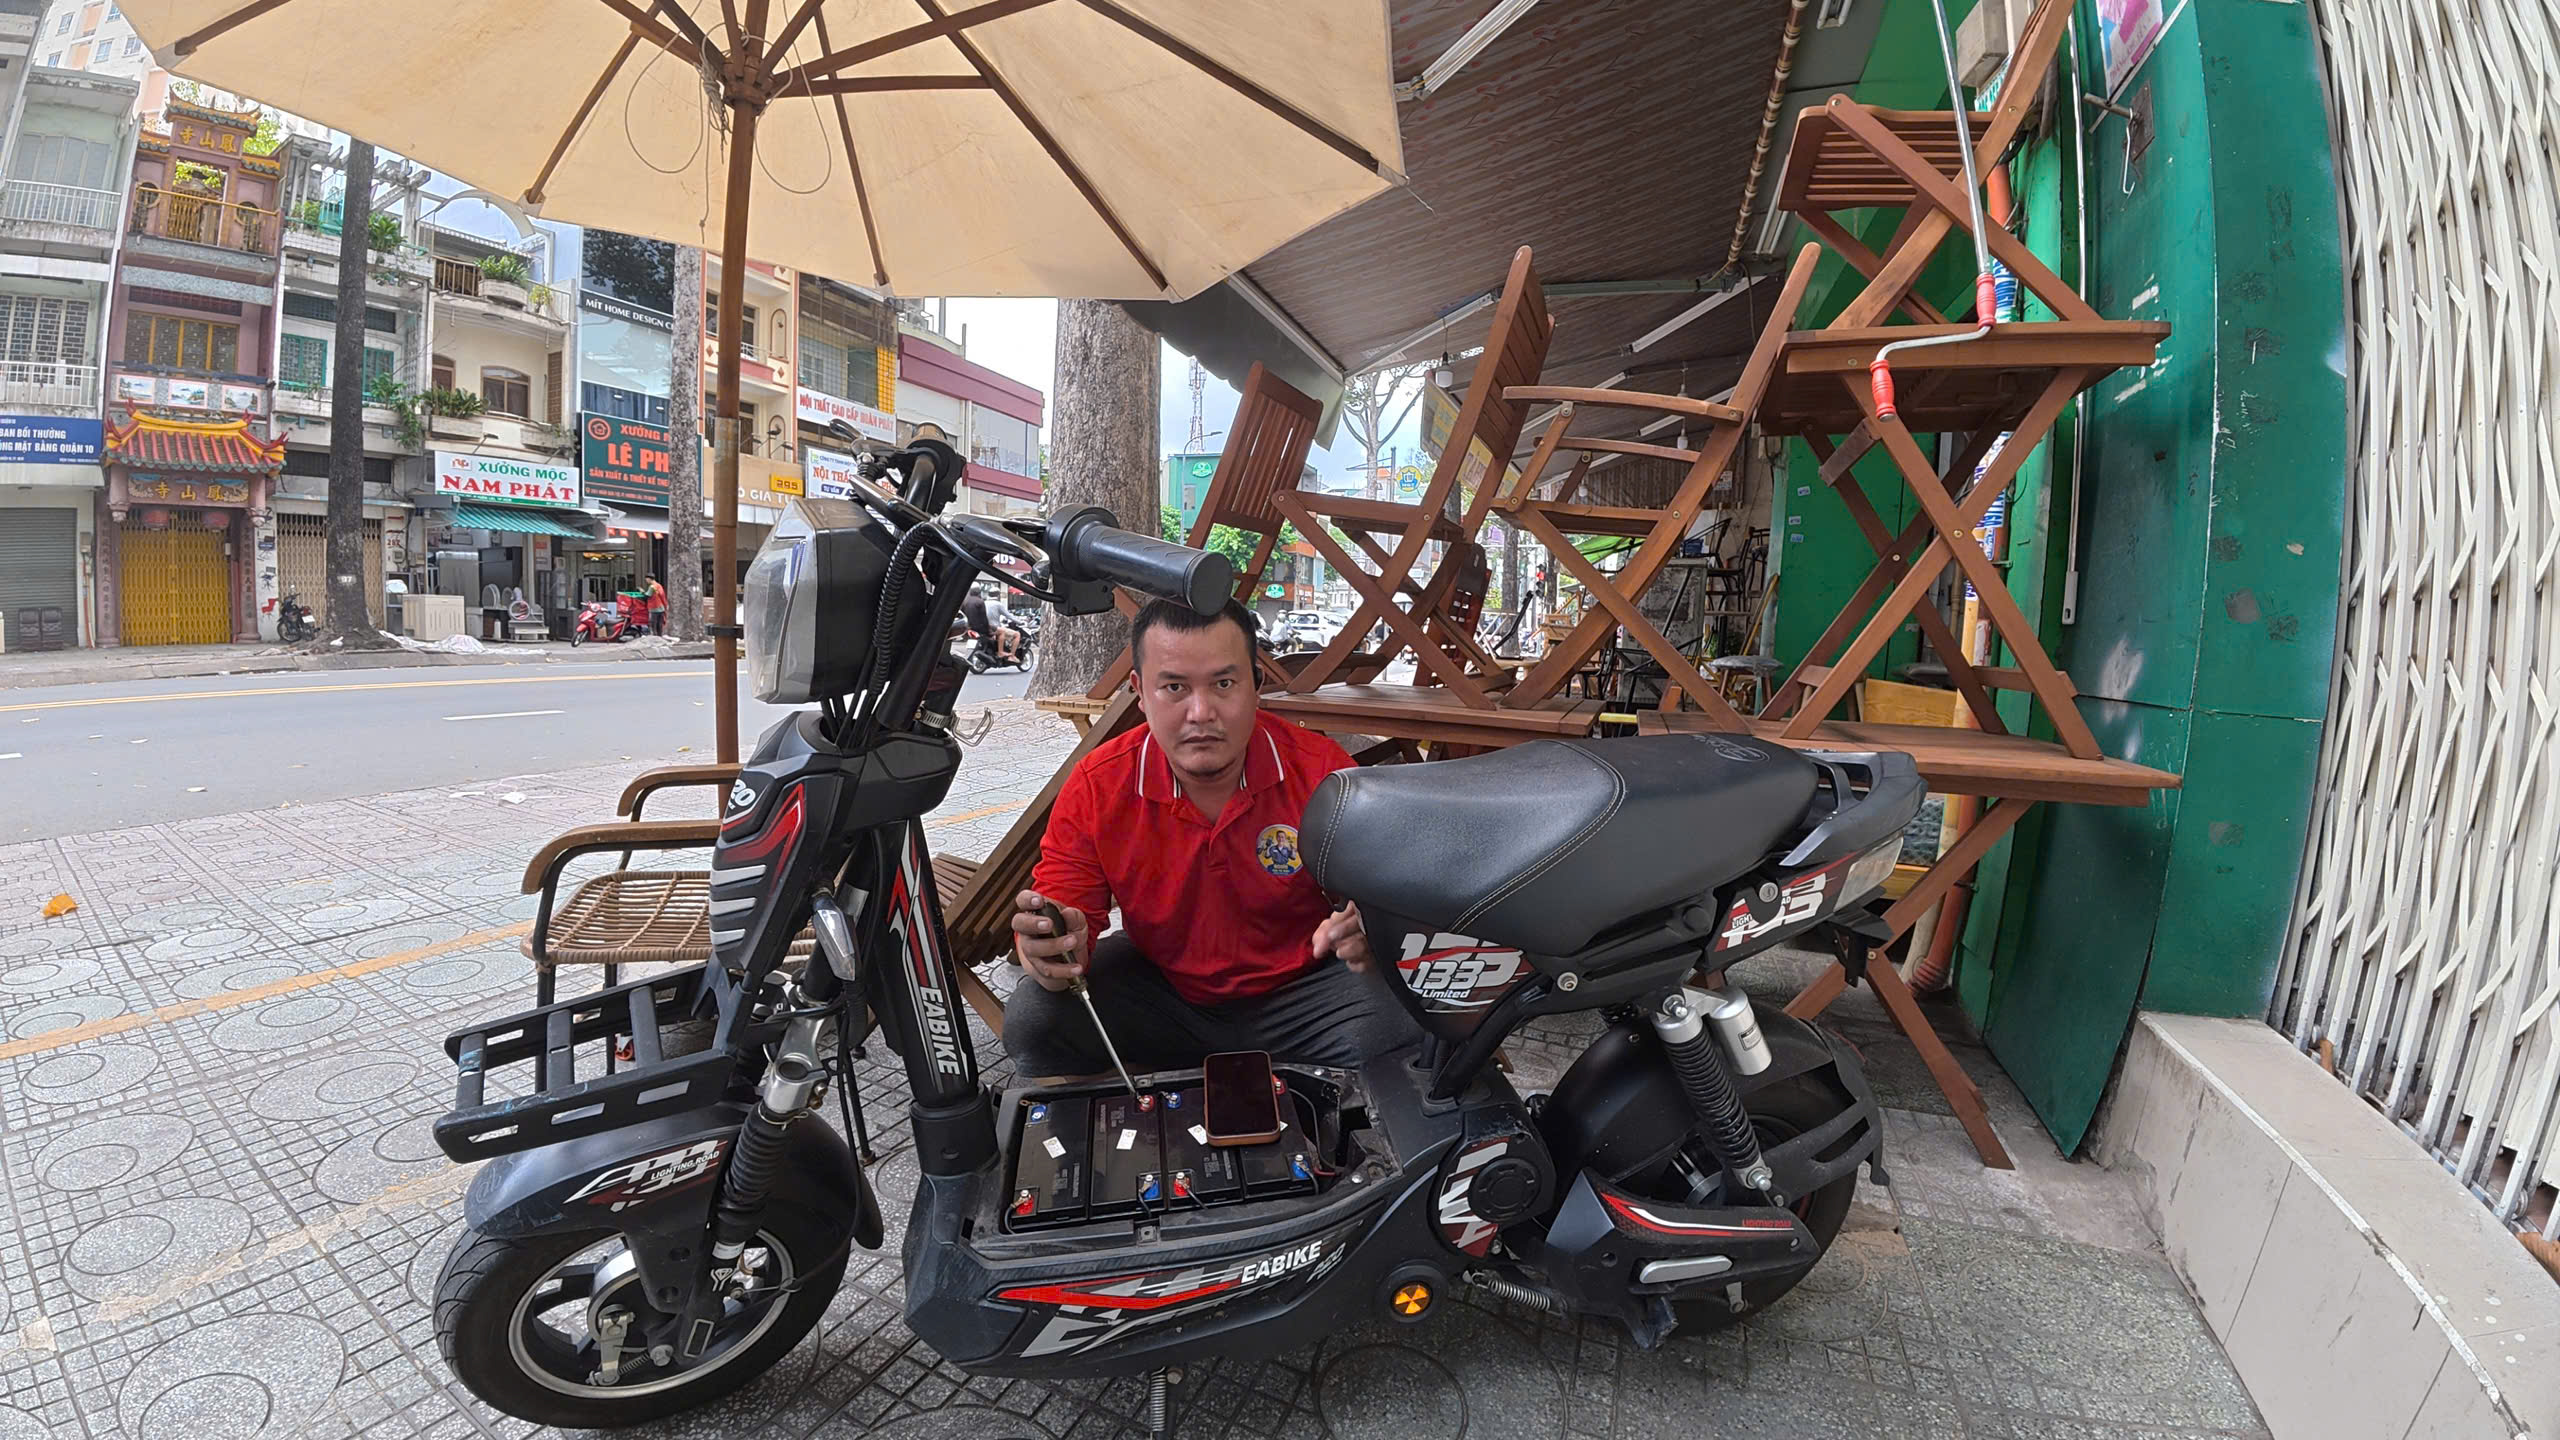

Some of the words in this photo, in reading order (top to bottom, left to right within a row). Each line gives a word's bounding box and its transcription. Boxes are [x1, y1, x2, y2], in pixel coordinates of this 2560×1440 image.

[604, 303, 631, 318] HOME
[632, 311, 664, 328] DESIGN
[799, 393, 812, 410] NỘI
[813, 397, 830, 414] THẤT
[832, 403, 845, 418] CAO
[33, 427, 66, 440] THƯỜNG
[620, 424, 661, 440] XƯỞNG
[15, 440, 32, 453] MẶT
[60, 442, 83, 455] QUẬN
[85, 445, 94, 454] 10
[607, 442, 632, 468] LÊ
[640, 448, 669, 473] PH
[478, 460, 530, 477] XƯỞNG
[535, 467, 568, 481] MỘC
[813, 465, 829, 480] NỘI
[831, 469, 849, 484] THẤ
[442, 474, 502, 495] NAM
[508, 482, 574, 501] PHÁT
[750, 489, 772, 502] GIA
[776, 479, 798, 490] 295
[1412, 960, 1485, 989] 133
[1422, 989, 1470, 999] Limited
[920, 986, 960, 1075] EABIKE
[651, 1160, 696, 1181] LIGHTING
[695, 1150, 720, 1166] ROAD
[1241, 1240, 1322, 1284] EABIKE
